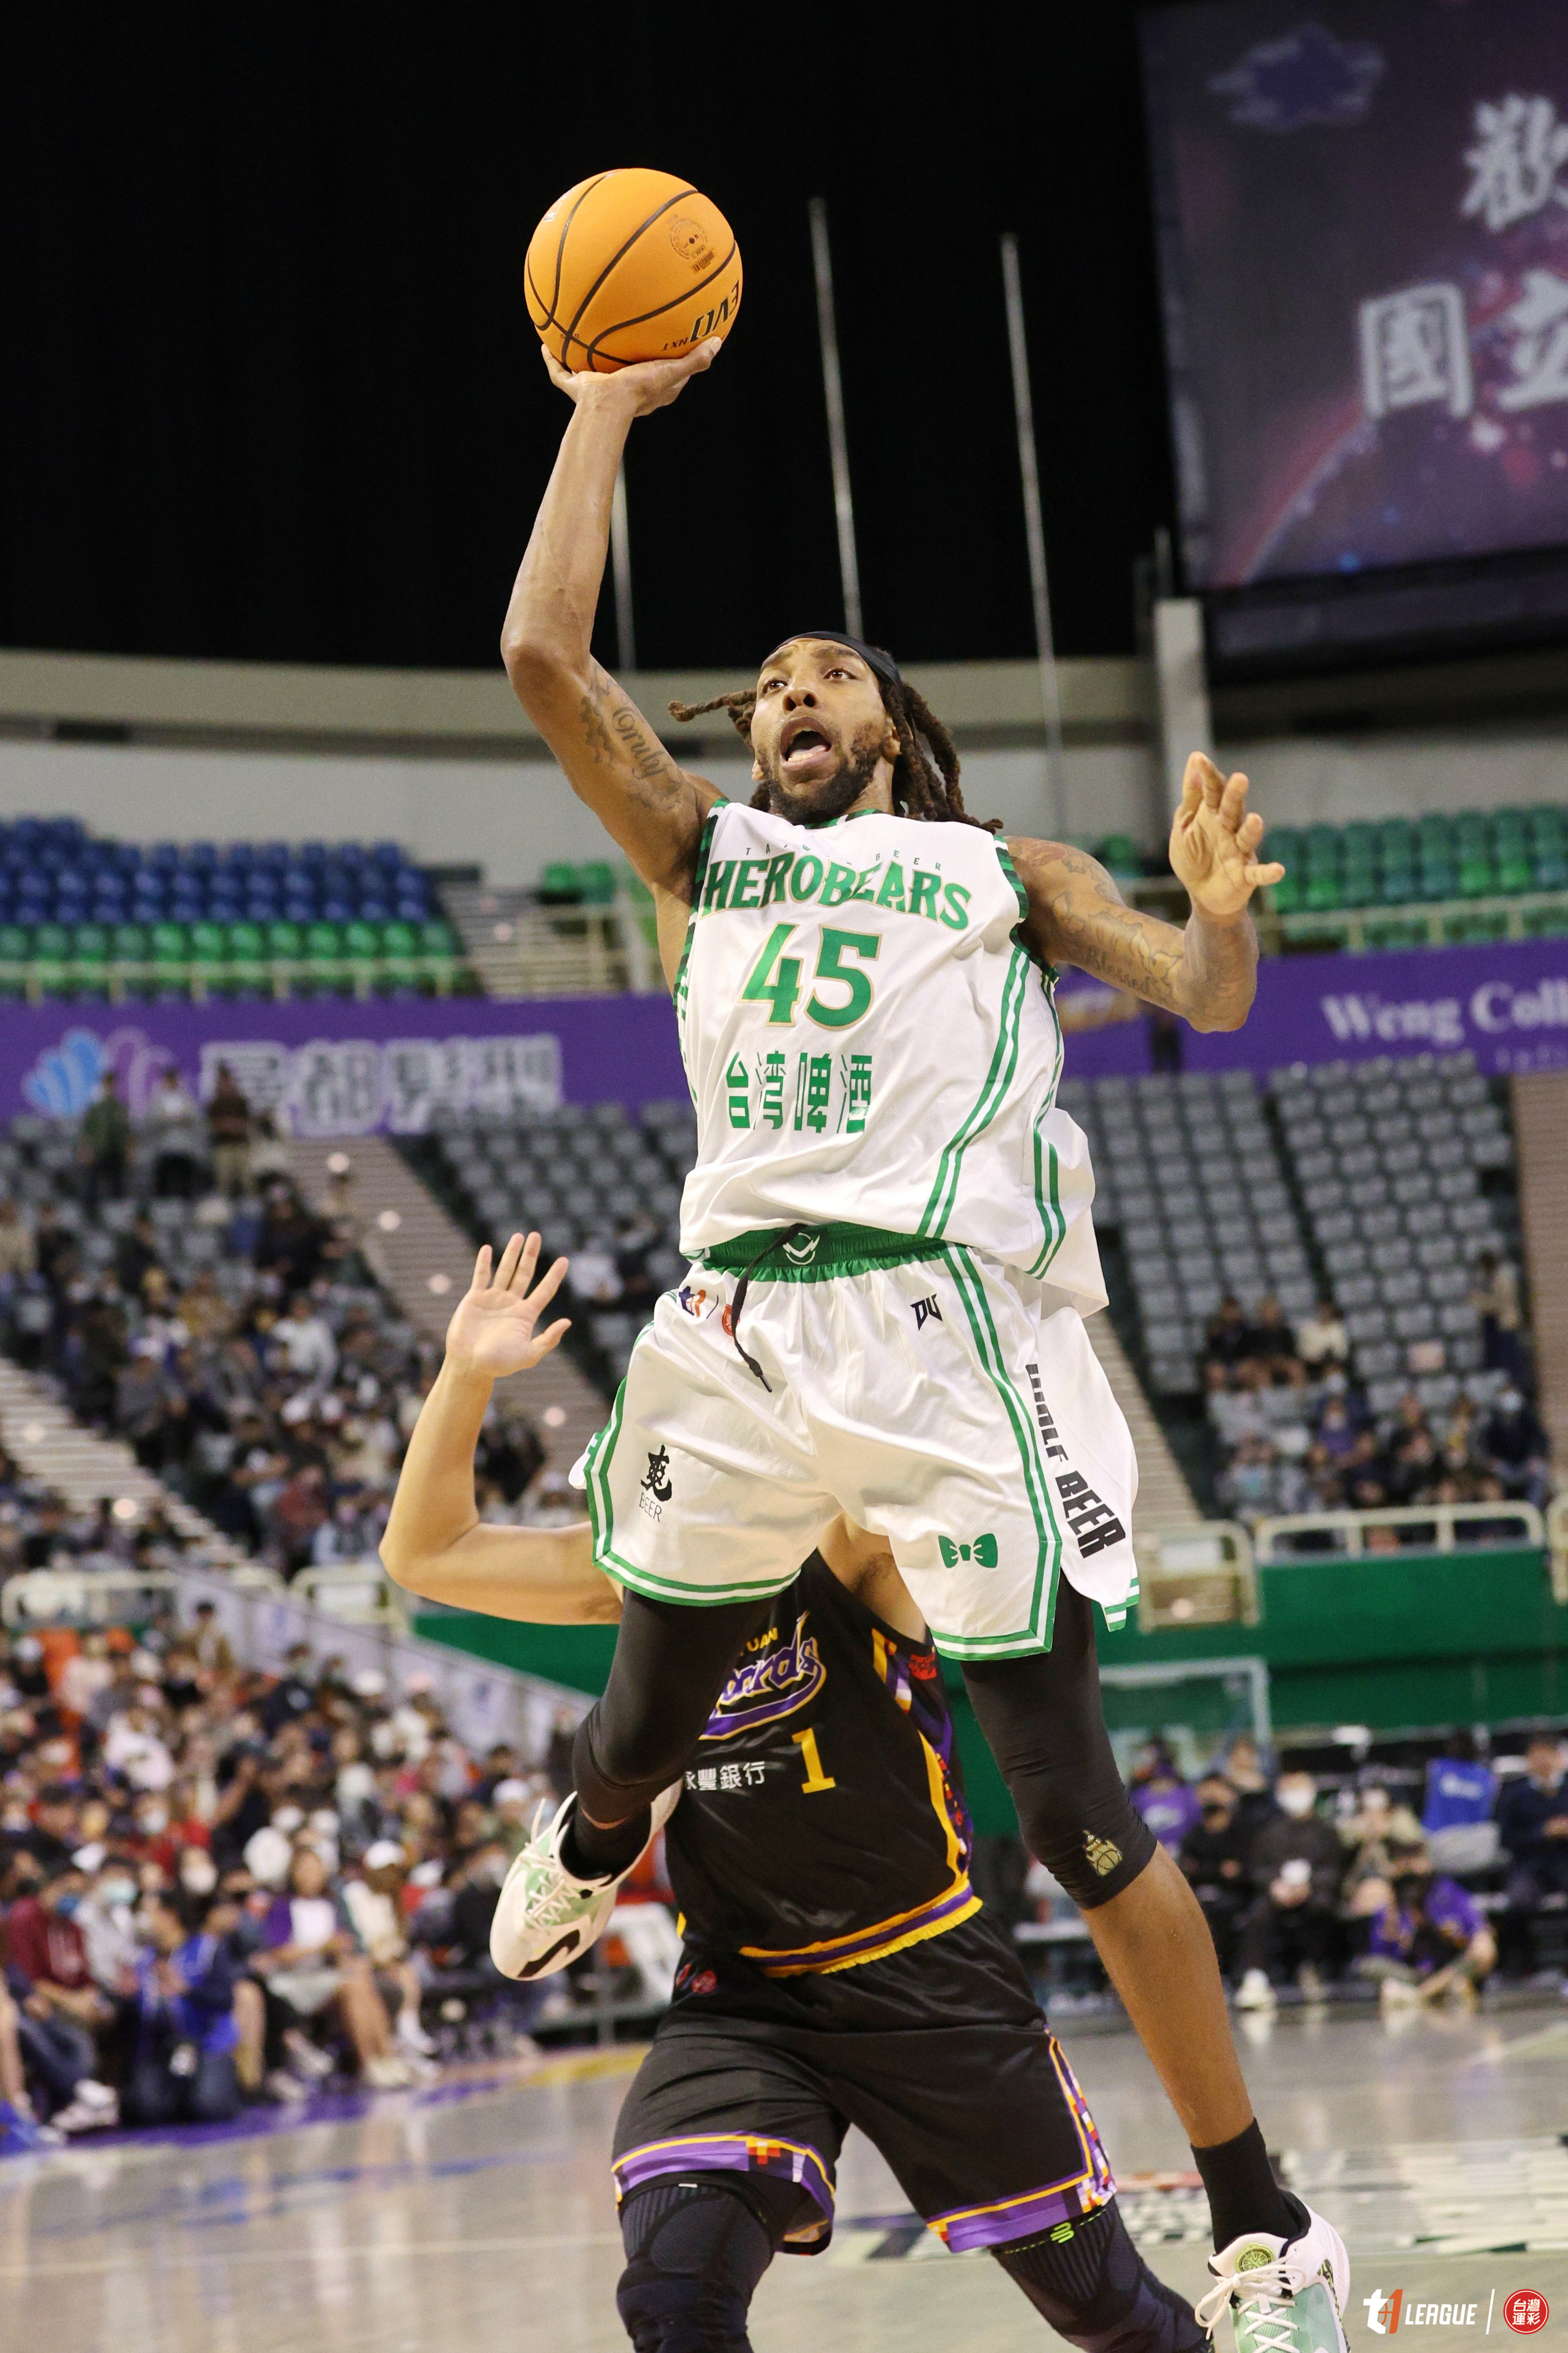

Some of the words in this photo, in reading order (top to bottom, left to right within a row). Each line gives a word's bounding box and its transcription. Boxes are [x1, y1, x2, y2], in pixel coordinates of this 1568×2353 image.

[699, 851, 972, 931] HEROBEARS
[876, 850, 941, 871] BEER
[739, 921, 883, 1032] 45
[639, 1492, 662, 1522] BEER
[1055, 1471, 1126, 1559] BEER
[792, 1728, 836, 1794] 1
